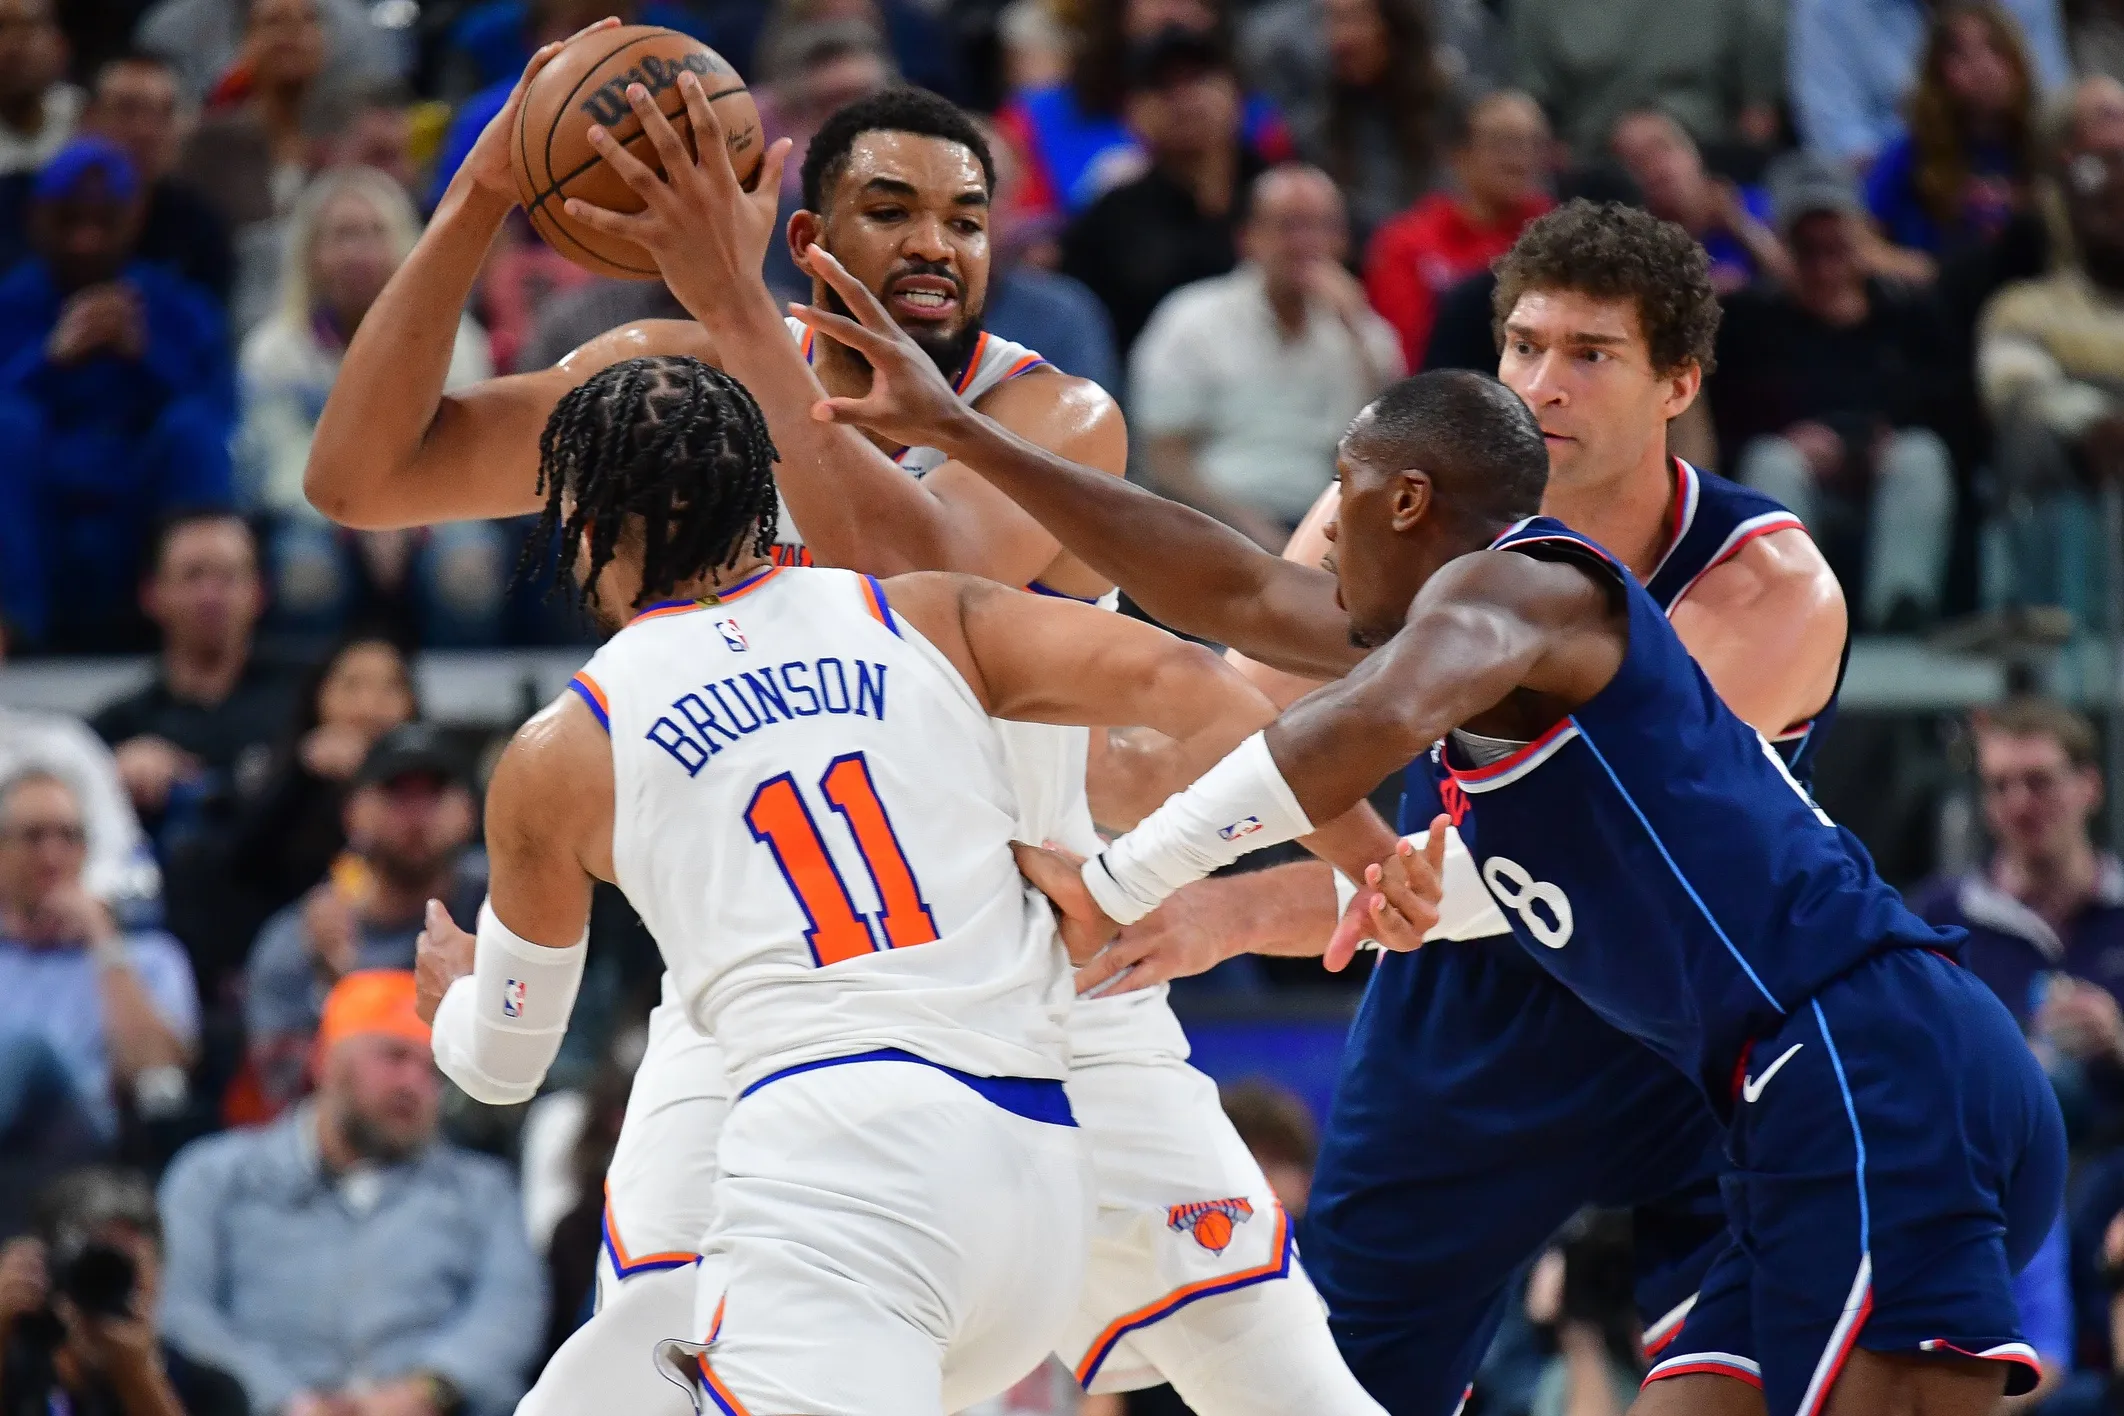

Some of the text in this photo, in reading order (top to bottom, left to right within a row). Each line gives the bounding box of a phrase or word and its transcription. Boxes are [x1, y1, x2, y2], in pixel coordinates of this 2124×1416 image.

[645, 657, 888, 778] BRUNSON
[743, 750, 942, 969] 11
[1483, 856, 1574, 949] 8
